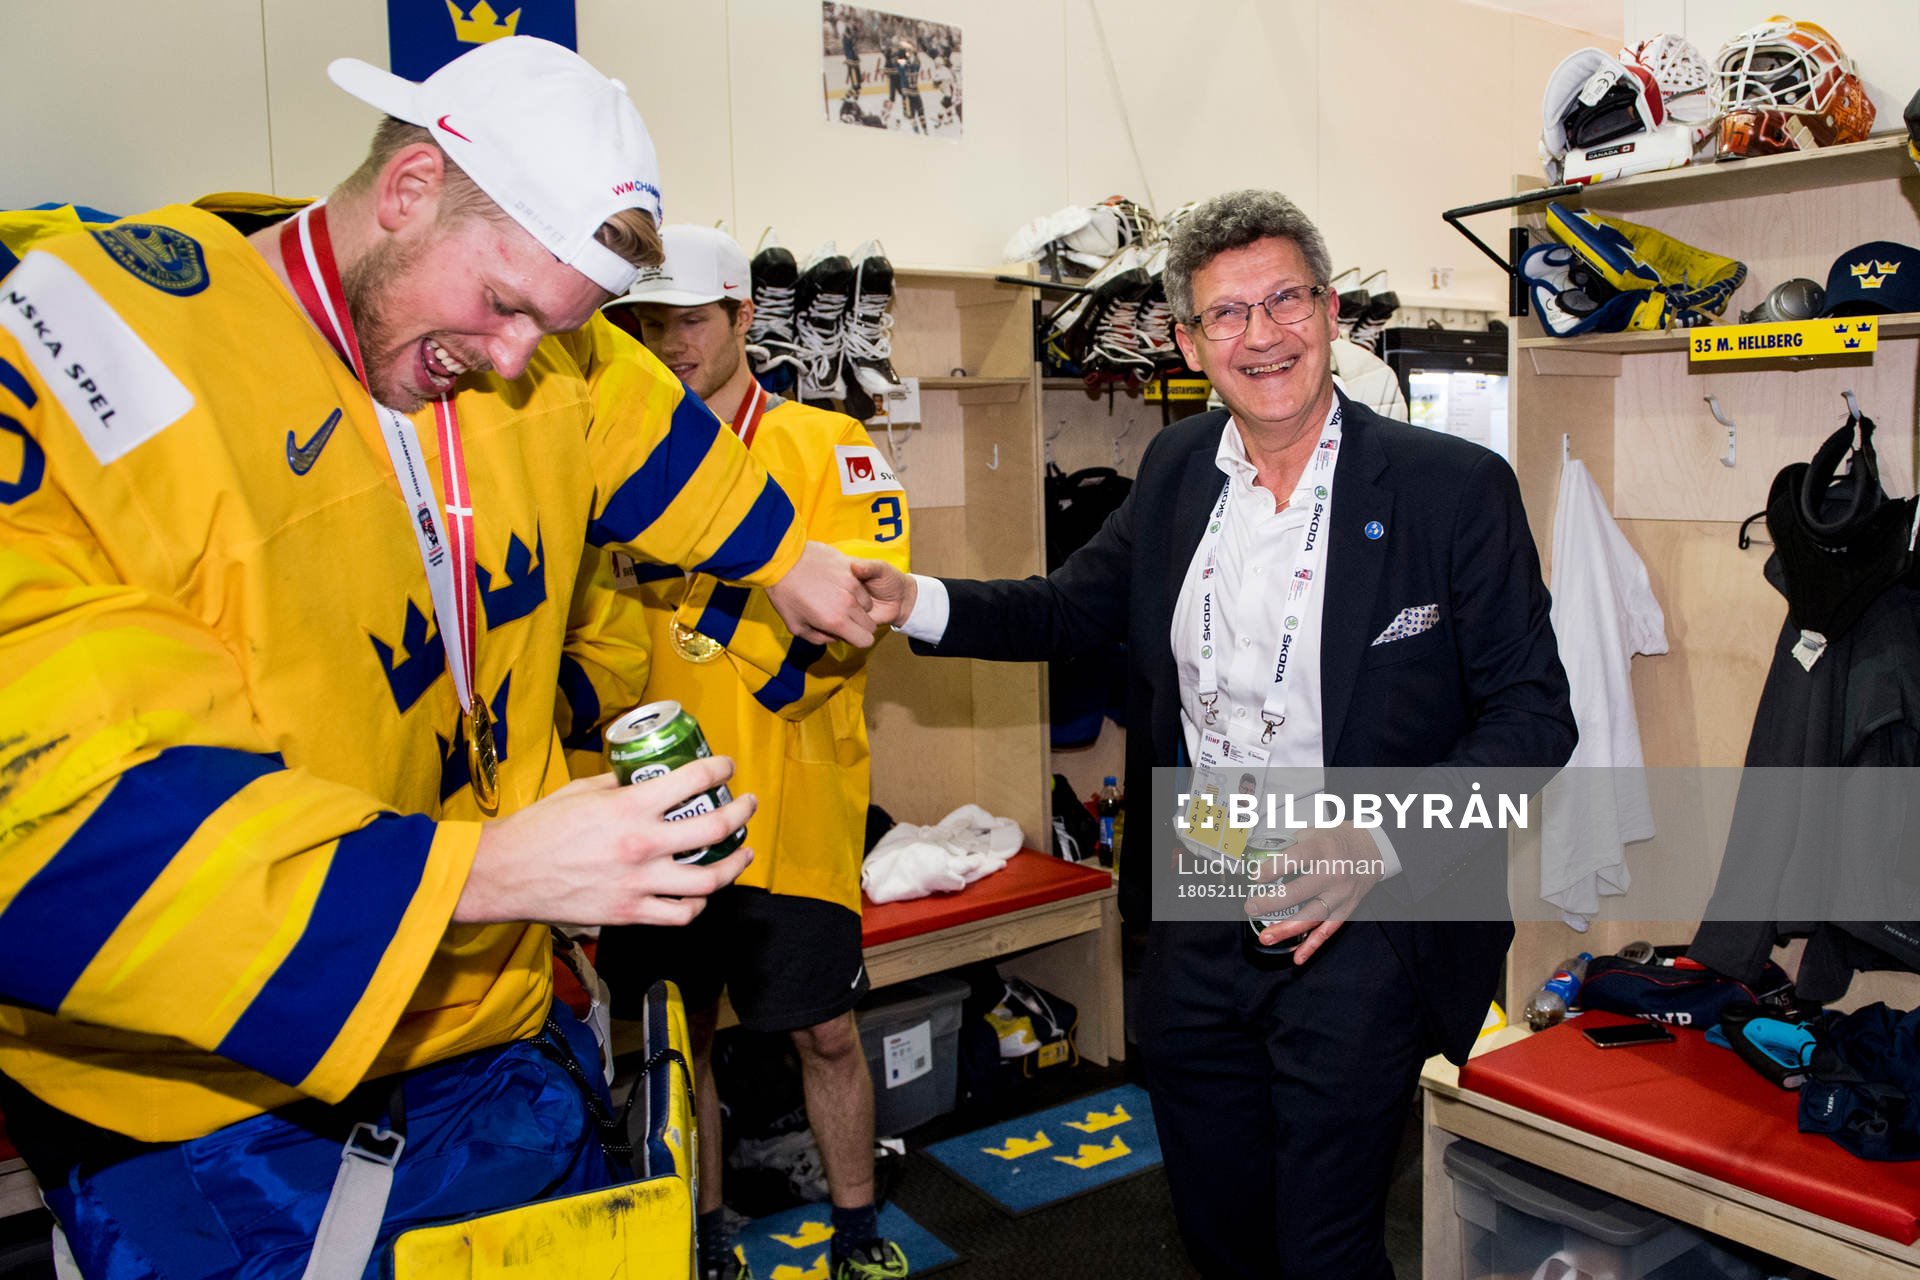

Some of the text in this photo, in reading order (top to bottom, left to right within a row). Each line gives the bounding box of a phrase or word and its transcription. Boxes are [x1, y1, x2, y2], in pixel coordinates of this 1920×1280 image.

[1588, 149, 1619, 160] CANADA
[1695, 333, 1803, 352] 35 M. HELLBERG
[64, 363, 116, 428] SPEL
[398, 430, 422, 498] CHAMPIONSHIP
[1304, 502, 1324, 552] ŠKODA
[1202, 592, 1212, 641] ŠKODA
[1274, 634, 1293, 684] ŠKODA
